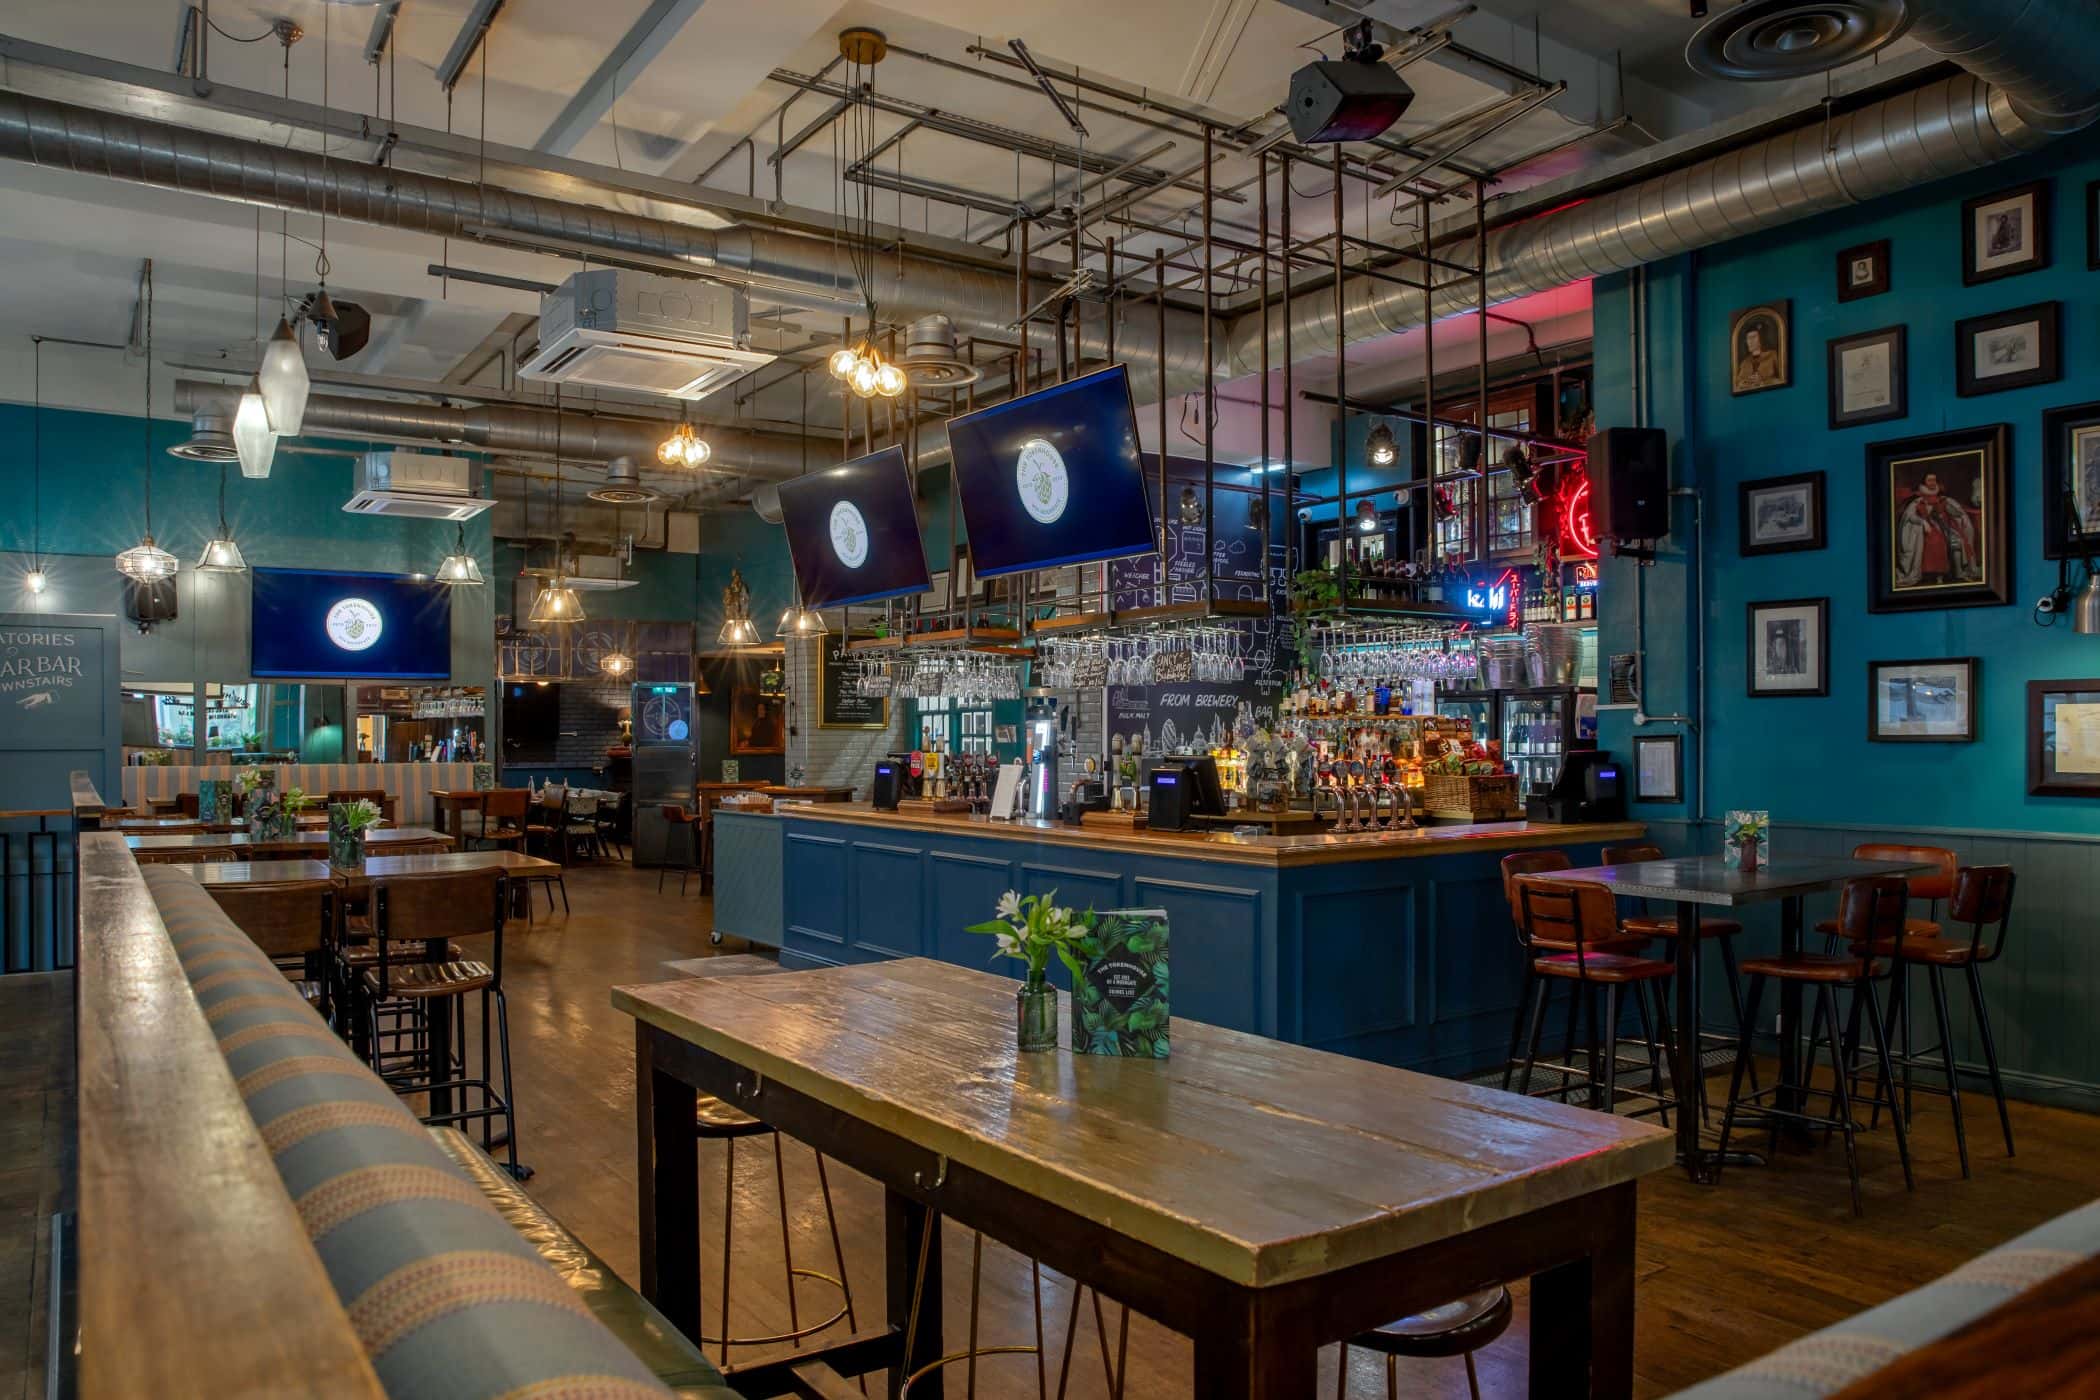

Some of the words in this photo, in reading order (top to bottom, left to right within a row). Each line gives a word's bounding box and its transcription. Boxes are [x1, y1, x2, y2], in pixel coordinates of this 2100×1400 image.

[37, 655, 83, 677] BAR
[0, 675, 73, 692] WNSTAIRS
[1160, 693, 1191, 707] FROM
[1195, 693, 1239, 707] BREWERY
